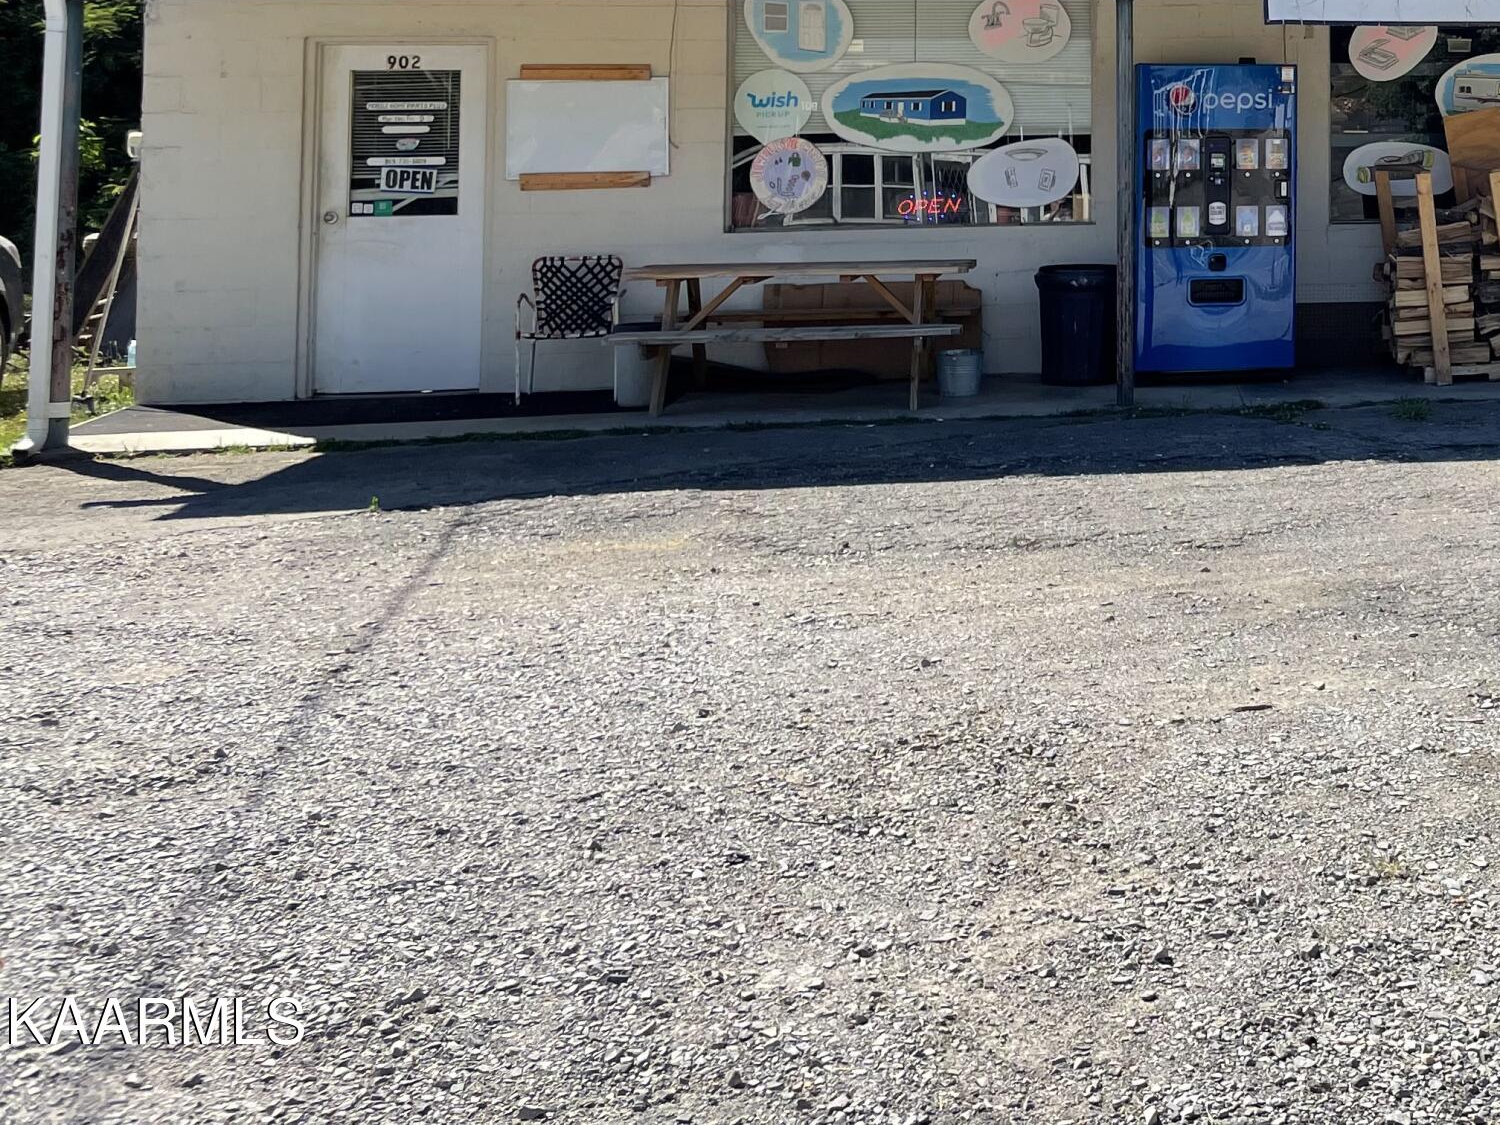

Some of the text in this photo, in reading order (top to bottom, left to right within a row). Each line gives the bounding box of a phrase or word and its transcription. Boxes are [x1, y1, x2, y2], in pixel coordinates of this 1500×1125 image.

[387, 55, 421, 69] 902
[746, 90, 799, 108] wish
[1202, 89, 1273, 114] pepsi
[385, 169, 434, 191] OPEN
[898, 197, 961, 215] OPEN
